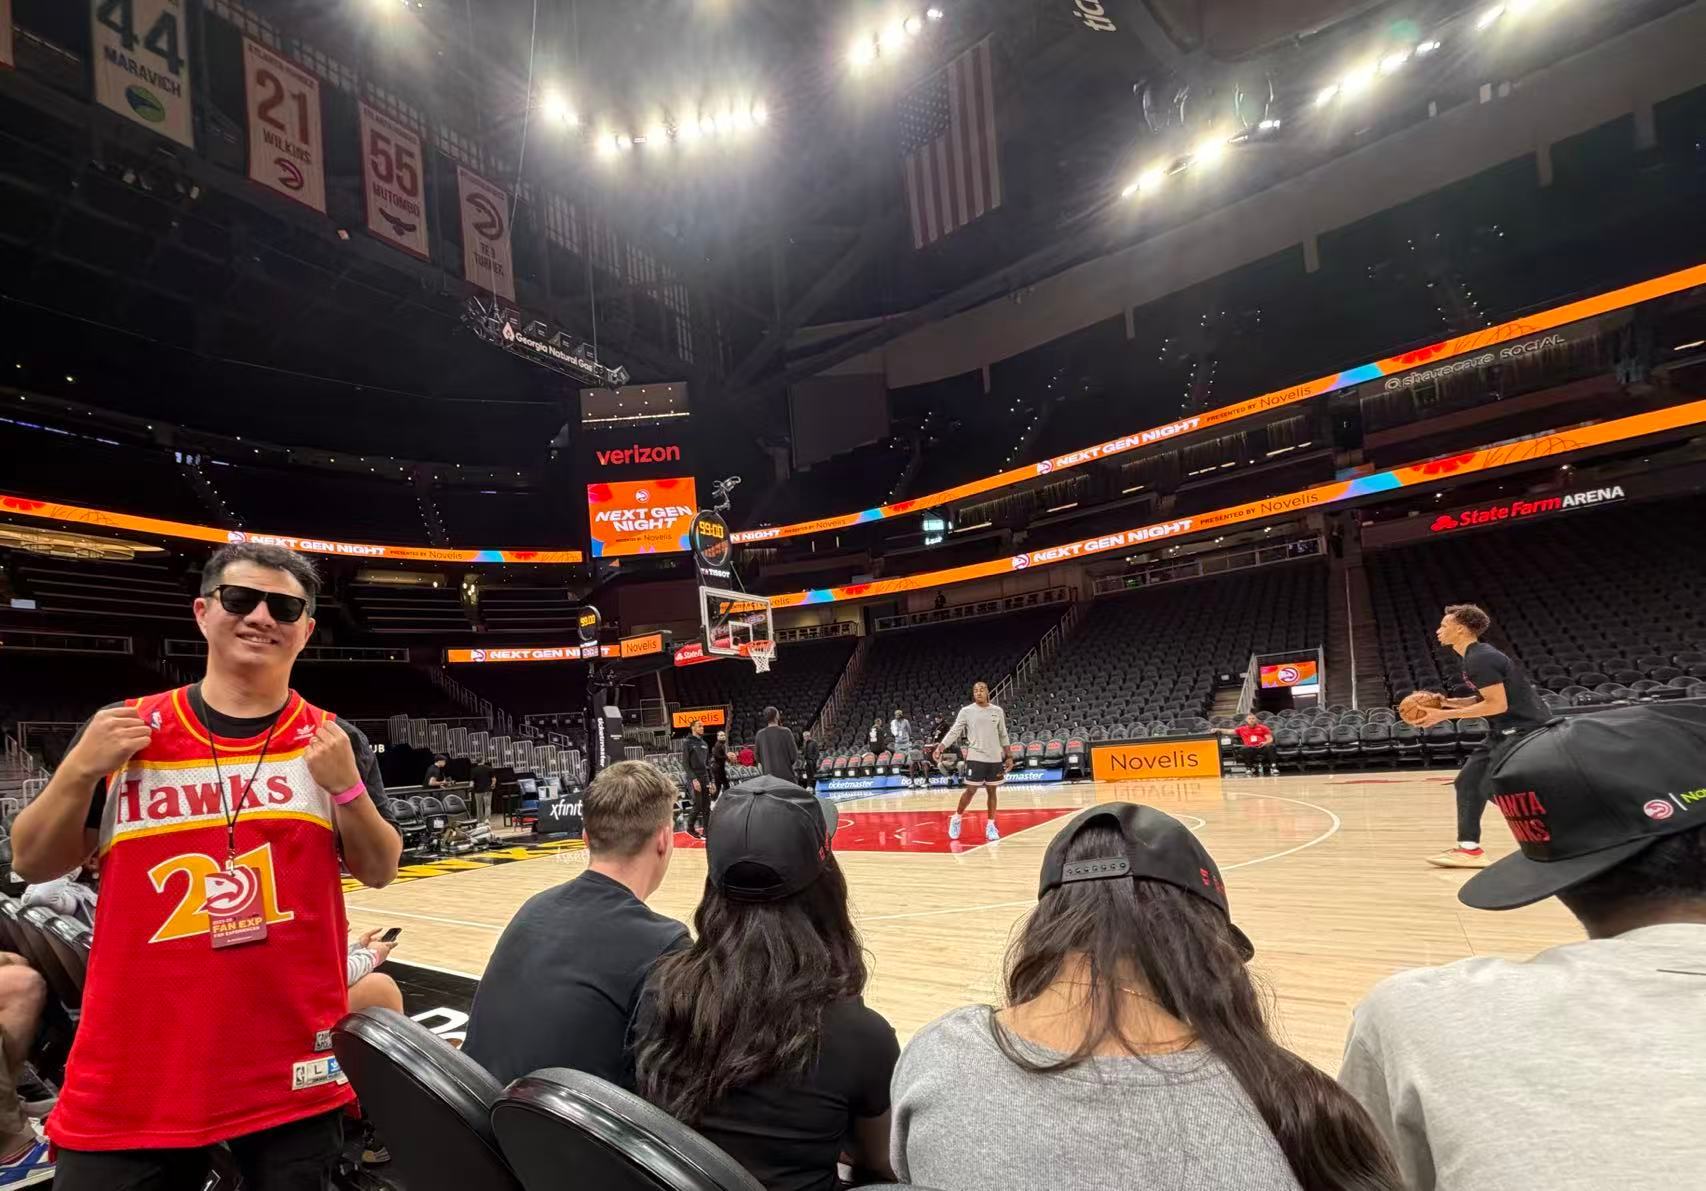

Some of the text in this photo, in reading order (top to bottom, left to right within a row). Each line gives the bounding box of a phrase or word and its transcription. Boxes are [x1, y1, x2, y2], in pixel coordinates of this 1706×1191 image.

[1073, 0, 1117, 32] tic
[97, 0, 185, 77] 44
[103, 45, 181, 98] MARAVICH
[256, 68, 310, 146] 21
[263, 128, 312, 165] WILKINS
[369, 128, 419, 197] 55
[515, 332, 593, 372] Georgia Natural Gas
[1402, 334, 1566, 388] sharecare SOCIAL
[1055, 386, 1312, 467] NEXT GEN NIGHT PRESENTED BY Novelis
[596, 444, 681, 466] verizon
[595, 505, 693, 523] NEXT GEN
[1458, 485, 1625, 527] State Farm ARENA
[612, 517, 677, 532] NIGHT
[742, 529, 781, 542] NIGHT
[1033, 491, 1319, 563] NEXT GEN NIGHT PRESENTED BY Novelis
[250, 535, 299, 548] NEXT
[300, 540, 335, 551] GEN
[336, 544, 385, 556] NIGHT
[428, 551, 463, 560] Novelis
[708, 568, 731, 579] TISSOT
[490, 647, 611, 659] NEXT GEN NIT
[626, 640, 657, 653] Novelis
[678, 711, 719, 724] Novelis
[1111, 750, 1199, 771] Novelis
[828, 779, 875, 790] ticketmaster
[1004, 770, 1044, 781] tmaster
[117, 774, 293, 825] Hawks
[1494, 791, 1548, 817] ANTA
[147, 842, 295, 944] 21
[212, 916, 263, 934] FAN EXP
[314, 1064, 322, 1075] L
